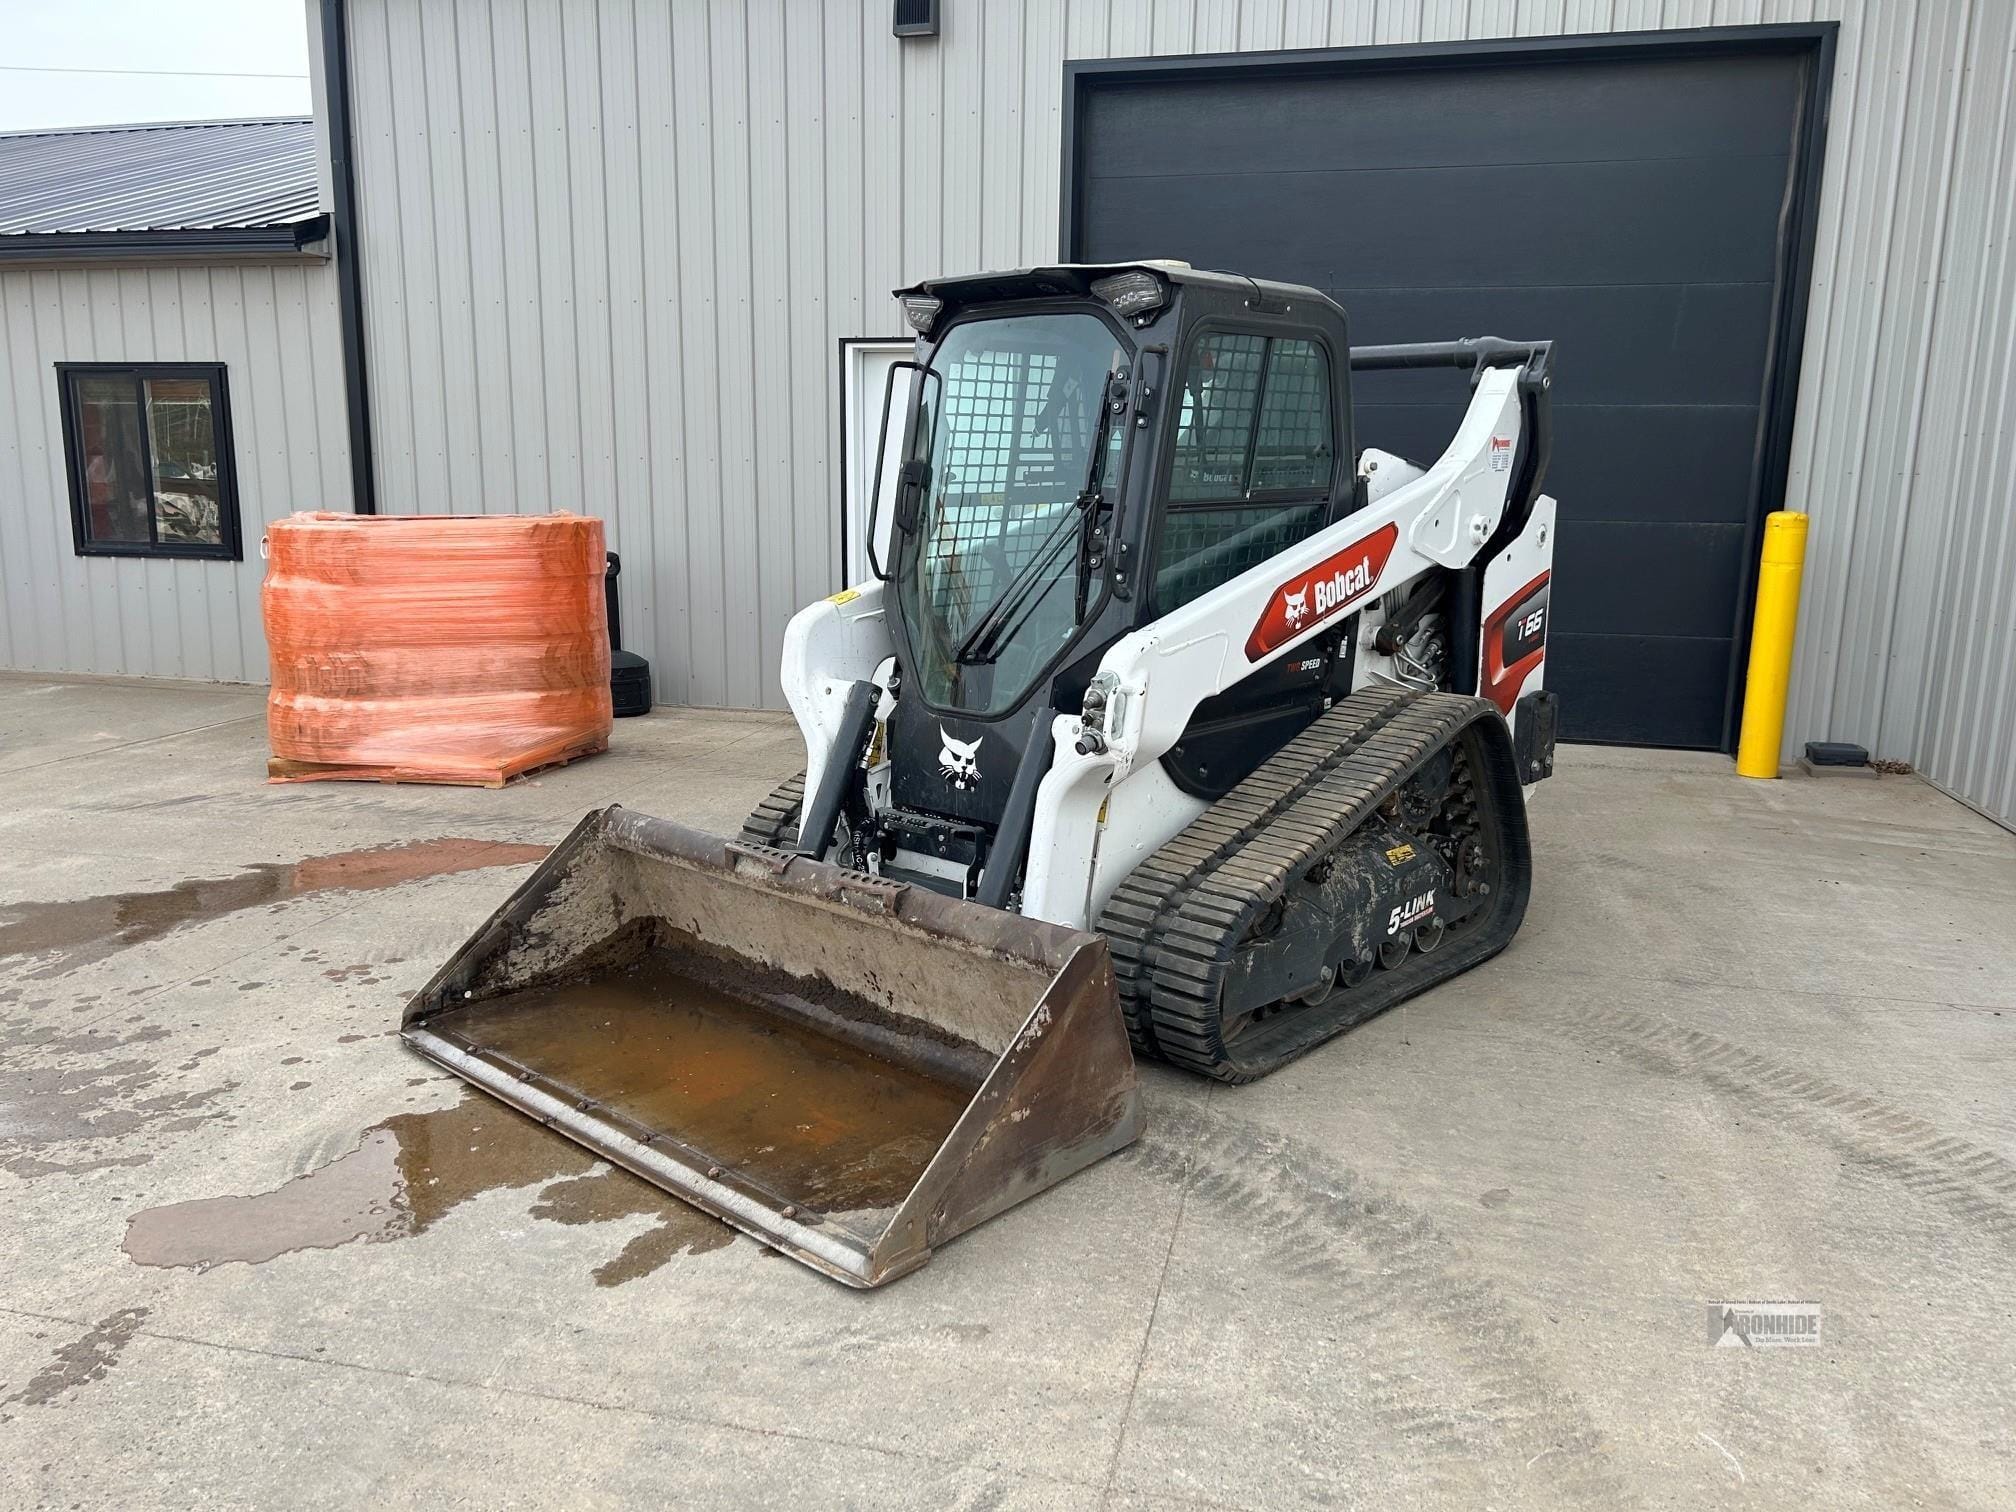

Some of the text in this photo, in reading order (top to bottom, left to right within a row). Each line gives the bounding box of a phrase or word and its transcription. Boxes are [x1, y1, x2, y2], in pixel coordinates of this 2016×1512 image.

[1314, 555, 1370, 616] Bobcat
[1517, 607, 1544, 641] T66
[1301, 658, 1321, 671] SPEED
[1387, 888, 1436, 935] 5-LINK
